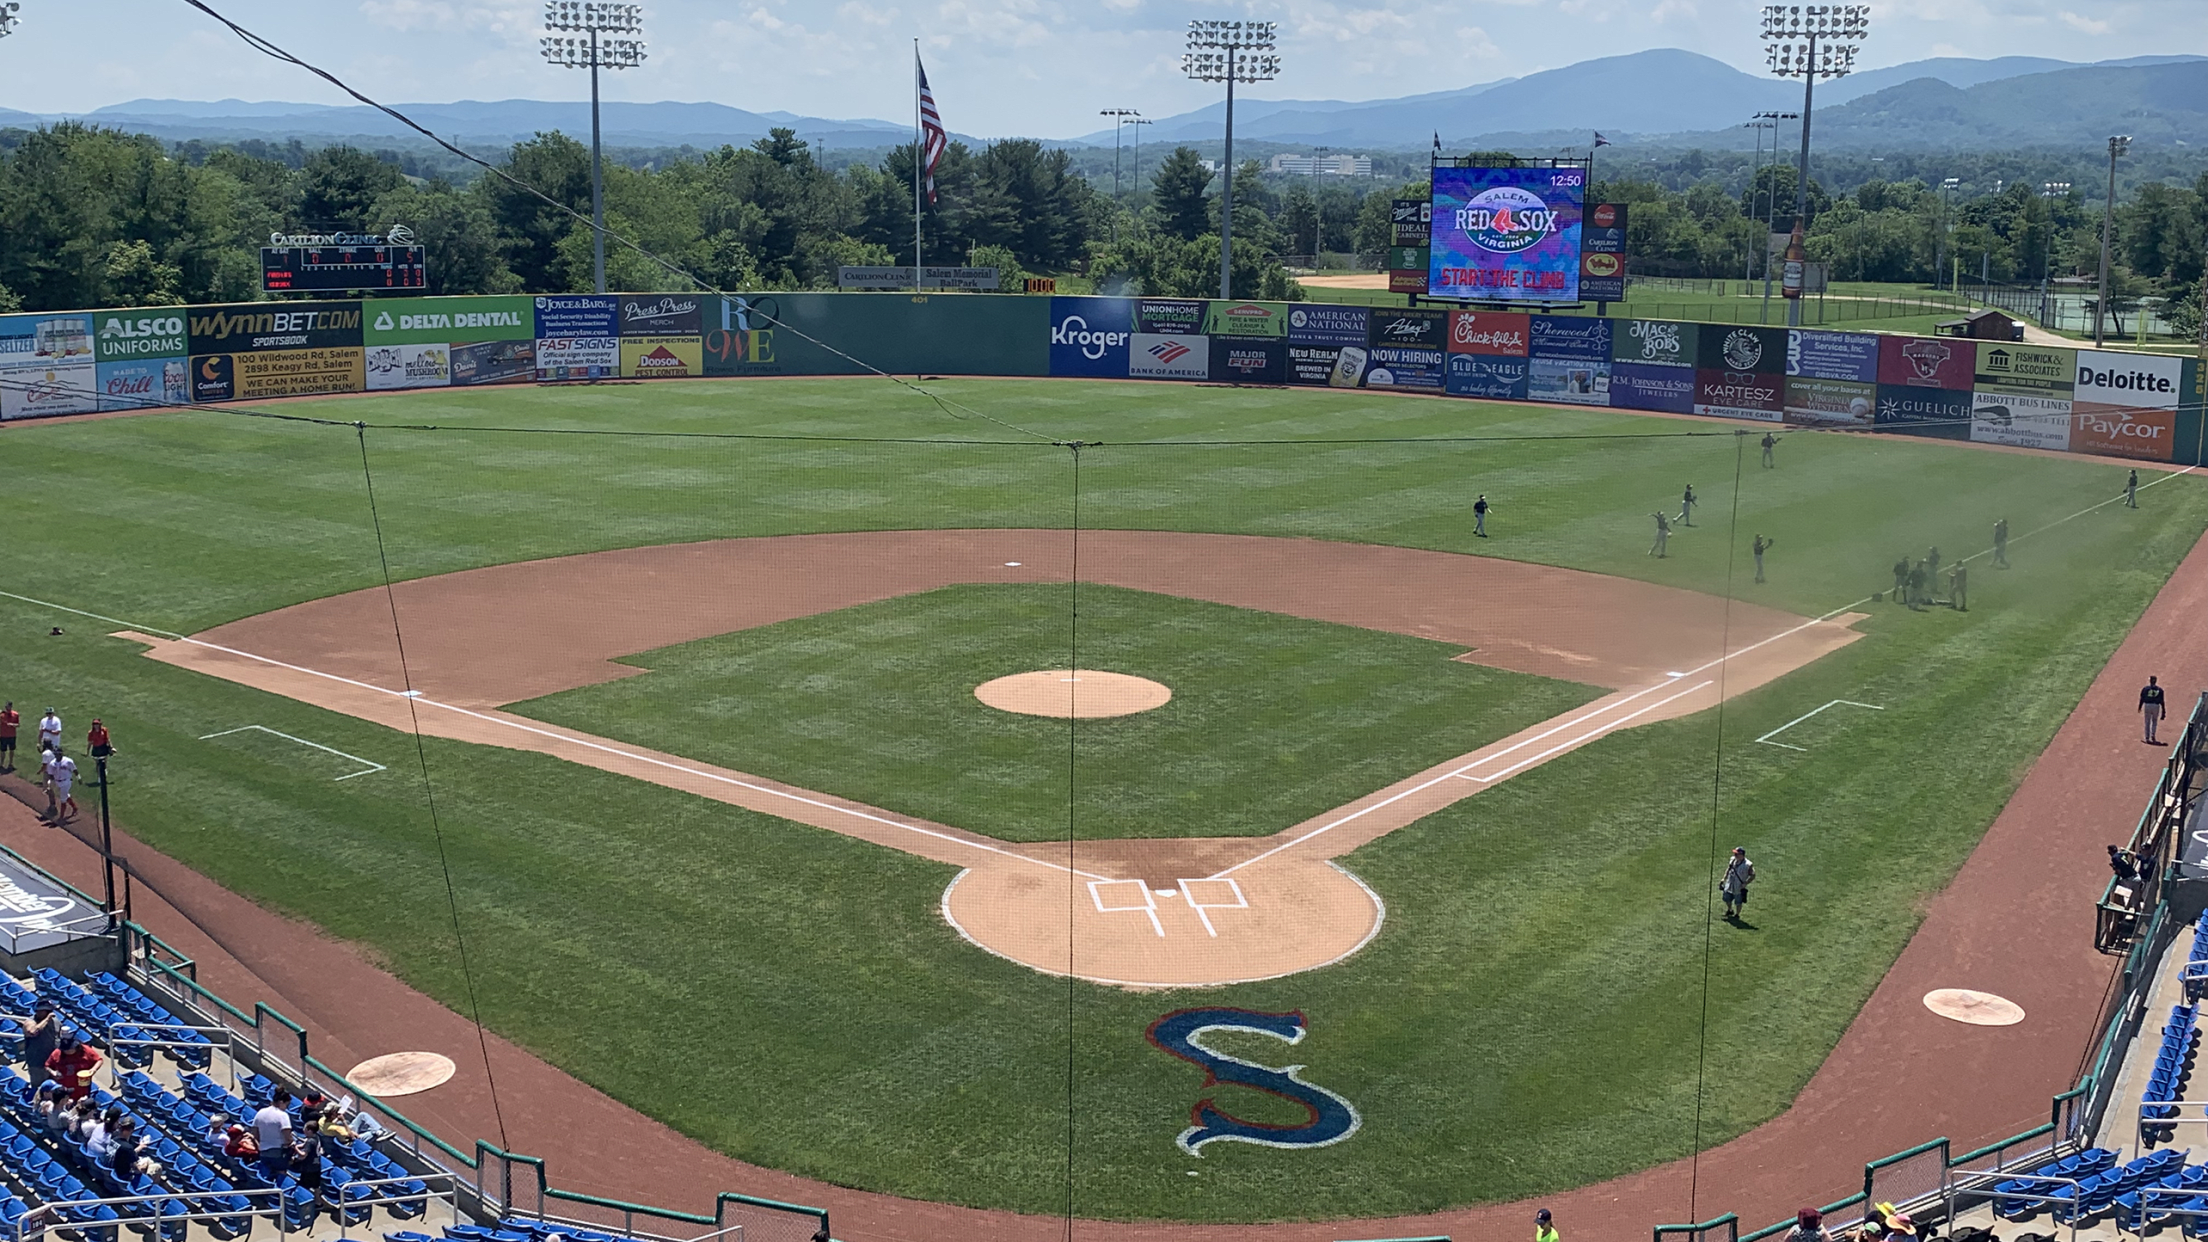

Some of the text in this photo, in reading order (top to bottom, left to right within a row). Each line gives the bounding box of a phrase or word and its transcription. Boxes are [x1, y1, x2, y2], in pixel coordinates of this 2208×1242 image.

[1550, 175, 1581, 187] 12:50
[1485, 192, 1530, 204] SALEM
[1454, 209, 1559, 232] RED SOX
[1397, 223, 1429, 232] IDEAL
[1478, 232, 1533, 249] VIRGINIA
[926, 268, 992, 278] Salem Memorial
[1441, 268, 1566, 289] START THE CLIMB
[940, 279, 977, 287] BallPark
[625, 297, 697, 320] Press Press
[400, 311, 522, 330] DELTA DENTAL
[1142, 313, 1199, 322] MORTGAGE
[1309, 311, 1366, 321] AMERICAN
[101, 317, 184, 339] ALSCO
[1308, 320, 1365, 331] NATIONAL
[1530, 320, 1593, 337] Sherwood
[1629, 320, 1667, 340] MAC
[1051, 315, 1128, 360] Kroger
[1454, 320, 1523, 348] Chick-fil-A
[1803, 332, 1877, 347] Diversified Building
[0, 339, 35, 354] SELTZER
[102, 337, 183, 355] UNIFORMS
[252, 335, 308, 347] SPORTSBOOK
[537, 338, 617, 351] FASTSIGNS
[1532, 337, 1569, 347] Memorial
[1722, 328, 1760, 355] WHITE CLAW
[1230, 350, 1266, 358] MAJOR
[1289, 348, 1309, 358] NEW
[1310, 348, 1338, 360] REALM
[1503, 347, 1523, 355] Salem
[1851, 345, 1865, 353] Inc.
[237, 355, 255, 364] 100
[258, 352, 308, 363] Wildwood
[329, 349, 359, 359] Salem
[640, 355, 679, 367] DODSON
[1230, 359, 1265, 367] FUN
[1371, 349, 1400, 361] NOW
[1401, 350, 1442, 364] HIRING
[1615, 357, 1692, 368] www.macandbobs.com
[2015, 351, 2053, 365] FISHWICK
[244, 360, 353, 374] 2898 Keagy Salem
[635, 367, 688, 377] PEST CONTROL
[1130, 367, 1154, 375] BANK
[1168, 369, 1207, 377] AMERICA
[1452, 361, 1522, 375] BLUE EAGLE
[2013, 364, 2061, 377] ASSOCIATES
[106, 376, 155, 395] Chill
[198, 381, 229, 390] Comfort
[246, 374, 349, 388] WE CAN MAKE YOUR
[1631, 377, 1694, 391] JOHNSON & SONS
[242, 386, 288, 397] MEETING
[289, 386, 298, 394] A
[300, 384, 329, 393] HOME
[1638, 388, 1678, 398] JEWELERS
[1704, 384, 1775, 401] KARTESZ
[1811, 383, 1821, 391] all
[1822, 385, 1840, 393] your
[1840, 385, 1862, 394] bases
[1712, 396, 1764, 408] EYE CARE
[1808, 392, 1852, 404] VIRGINIA
[1975, 394, 2070, 411] ABBOTT BUS LINES
[1807, 401, 1850, 413] WESTERN
[1902, 400, 1971, 418] GUELICH
[1755, 411, 1773, 419] CARE
[1977, 425, 2064, 441] www.abbottbus.com
[2079, 413, 2166, 440] Paycor
[1145, 1005, 1363, 1159] S
